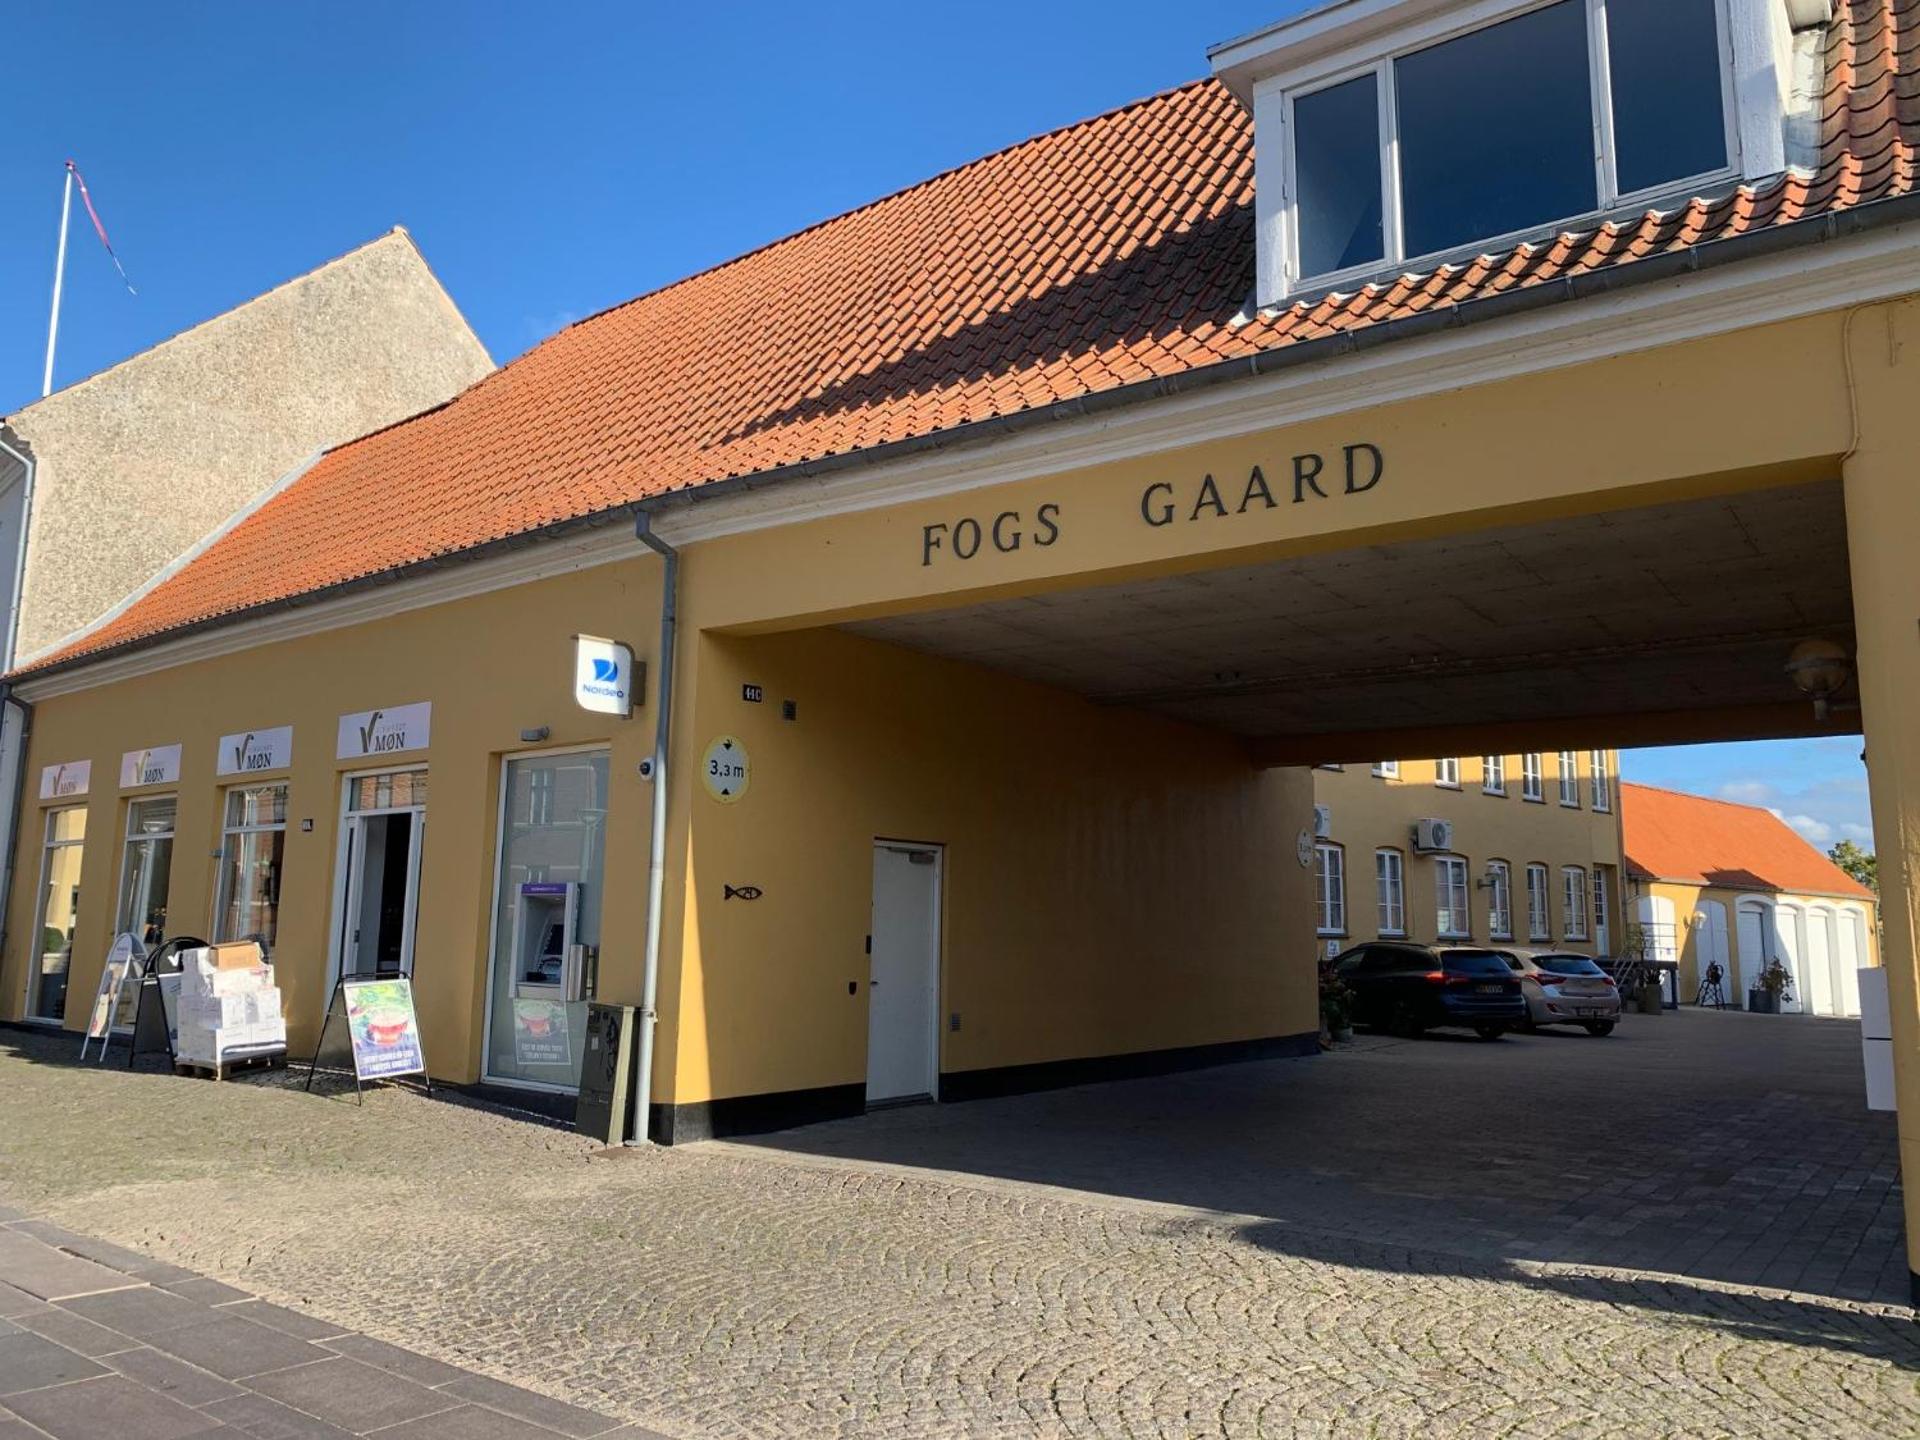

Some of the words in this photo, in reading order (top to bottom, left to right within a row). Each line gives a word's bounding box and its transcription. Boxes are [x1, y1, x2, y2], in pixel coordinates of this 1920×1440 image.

[921, 503, 1061, 567] FOGS
[1140, 442, 1384, 527] GAARD
[583, 684, 624, 698] Nordea
[375, 731, 405, 752] MØN
[246, 752, 272, 769] MØN
